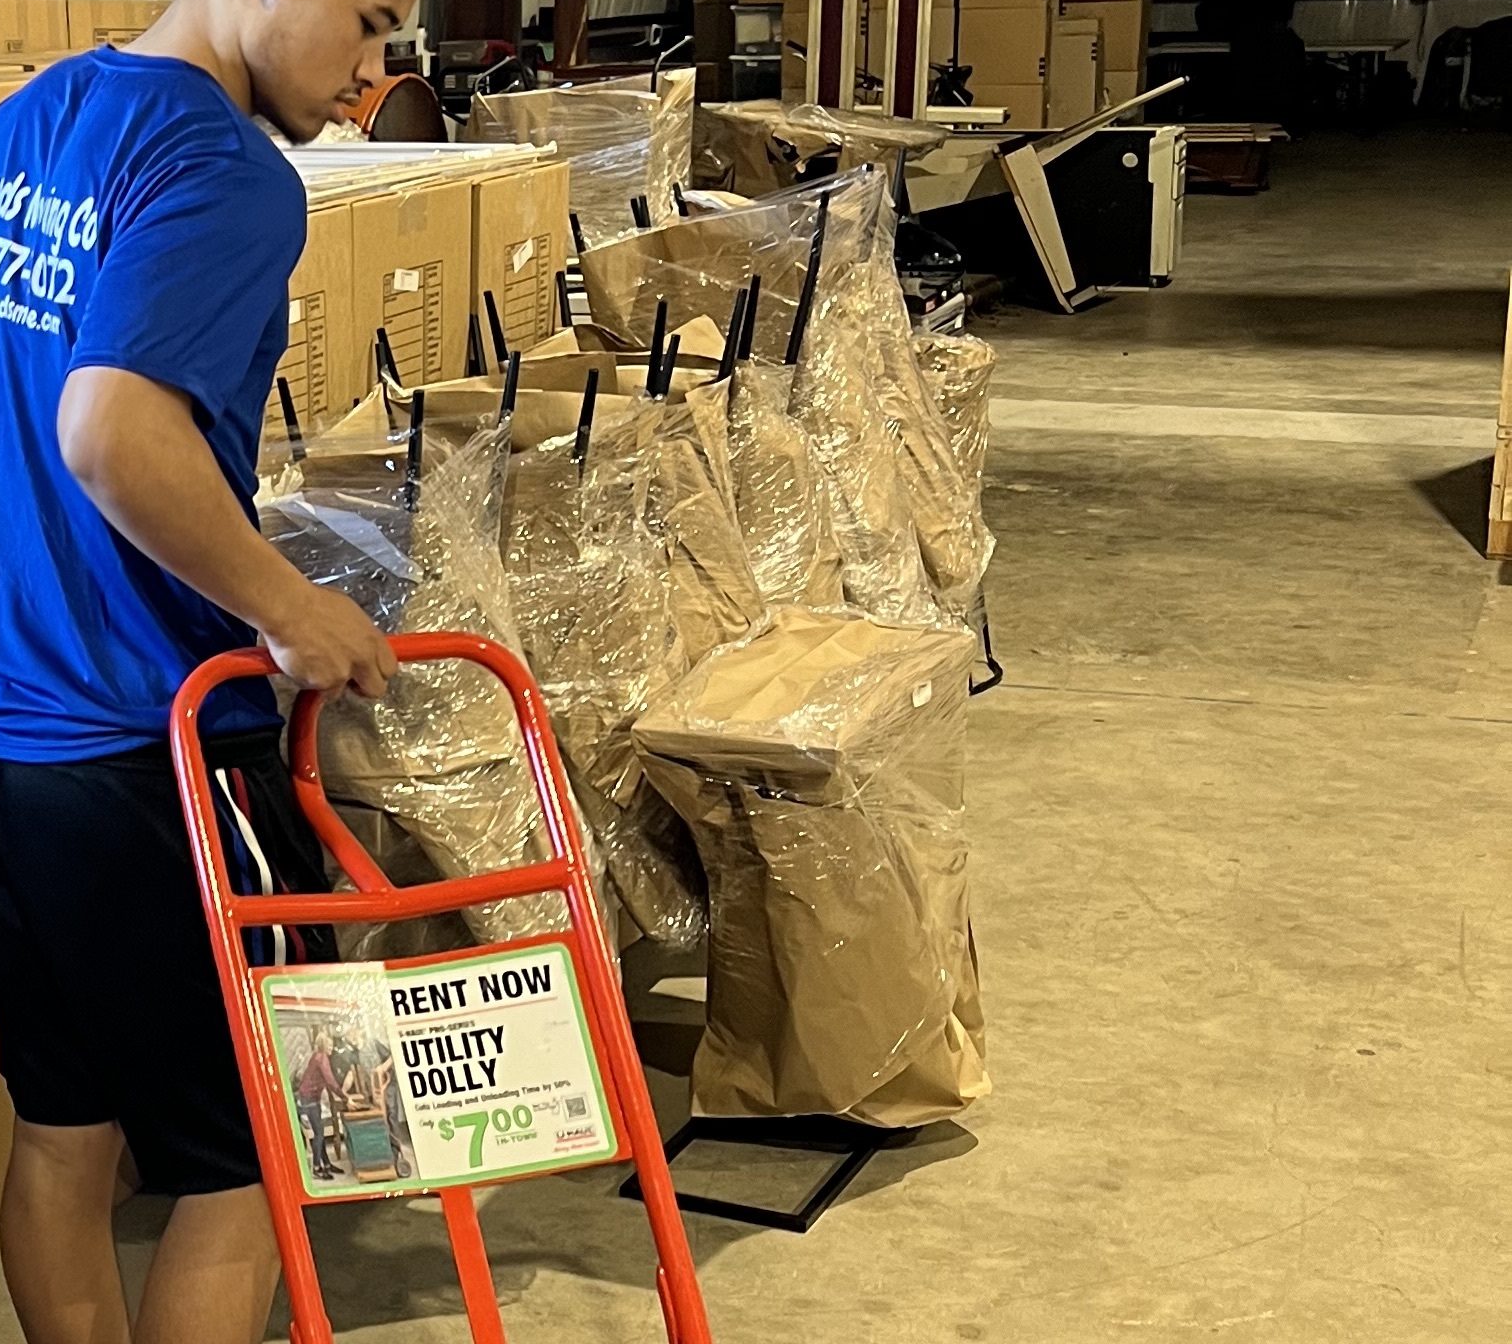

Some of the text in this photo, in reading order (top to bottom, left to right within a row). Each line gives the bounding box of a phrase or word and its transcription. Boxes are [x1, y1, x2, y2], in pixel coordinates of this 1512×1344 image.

[390, 964, 551, 1017] RENT NOW
[401, 1025, 504, 1068] UTILITY
[408, 1058, 497, 1099] DOLLY
[465, 1096, 479, 1104] and
[521, 1086, 540, 1095] Time
[542, 1083, 551, 1092] by
